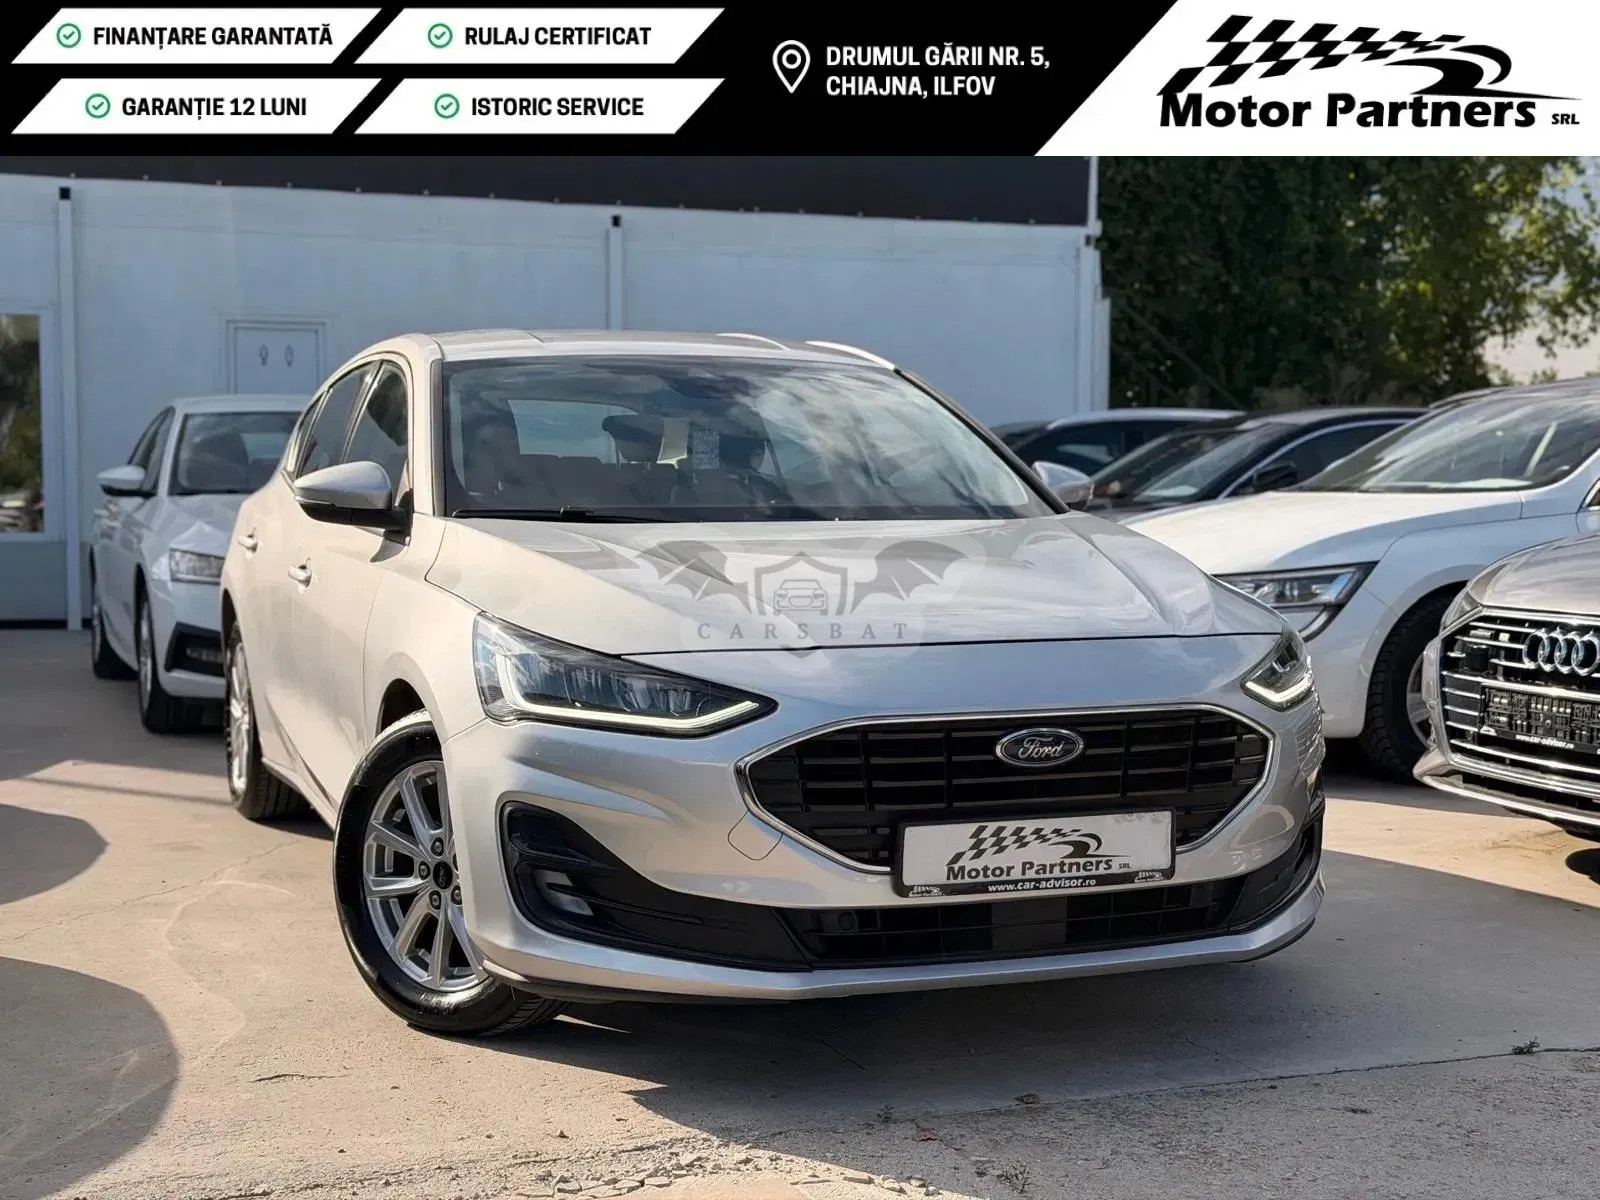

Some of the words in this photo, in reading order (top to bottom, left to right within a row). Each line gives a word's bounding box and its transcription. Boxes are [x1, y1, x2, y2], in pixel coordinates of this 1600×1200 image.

[1018, 736, 1064, 759] Ford
[946, 863, 1014, 880] Motor
[1021, 858, 1113, 876] Partners
[988, 878, 1096, 892] www.car-advisor.ro
